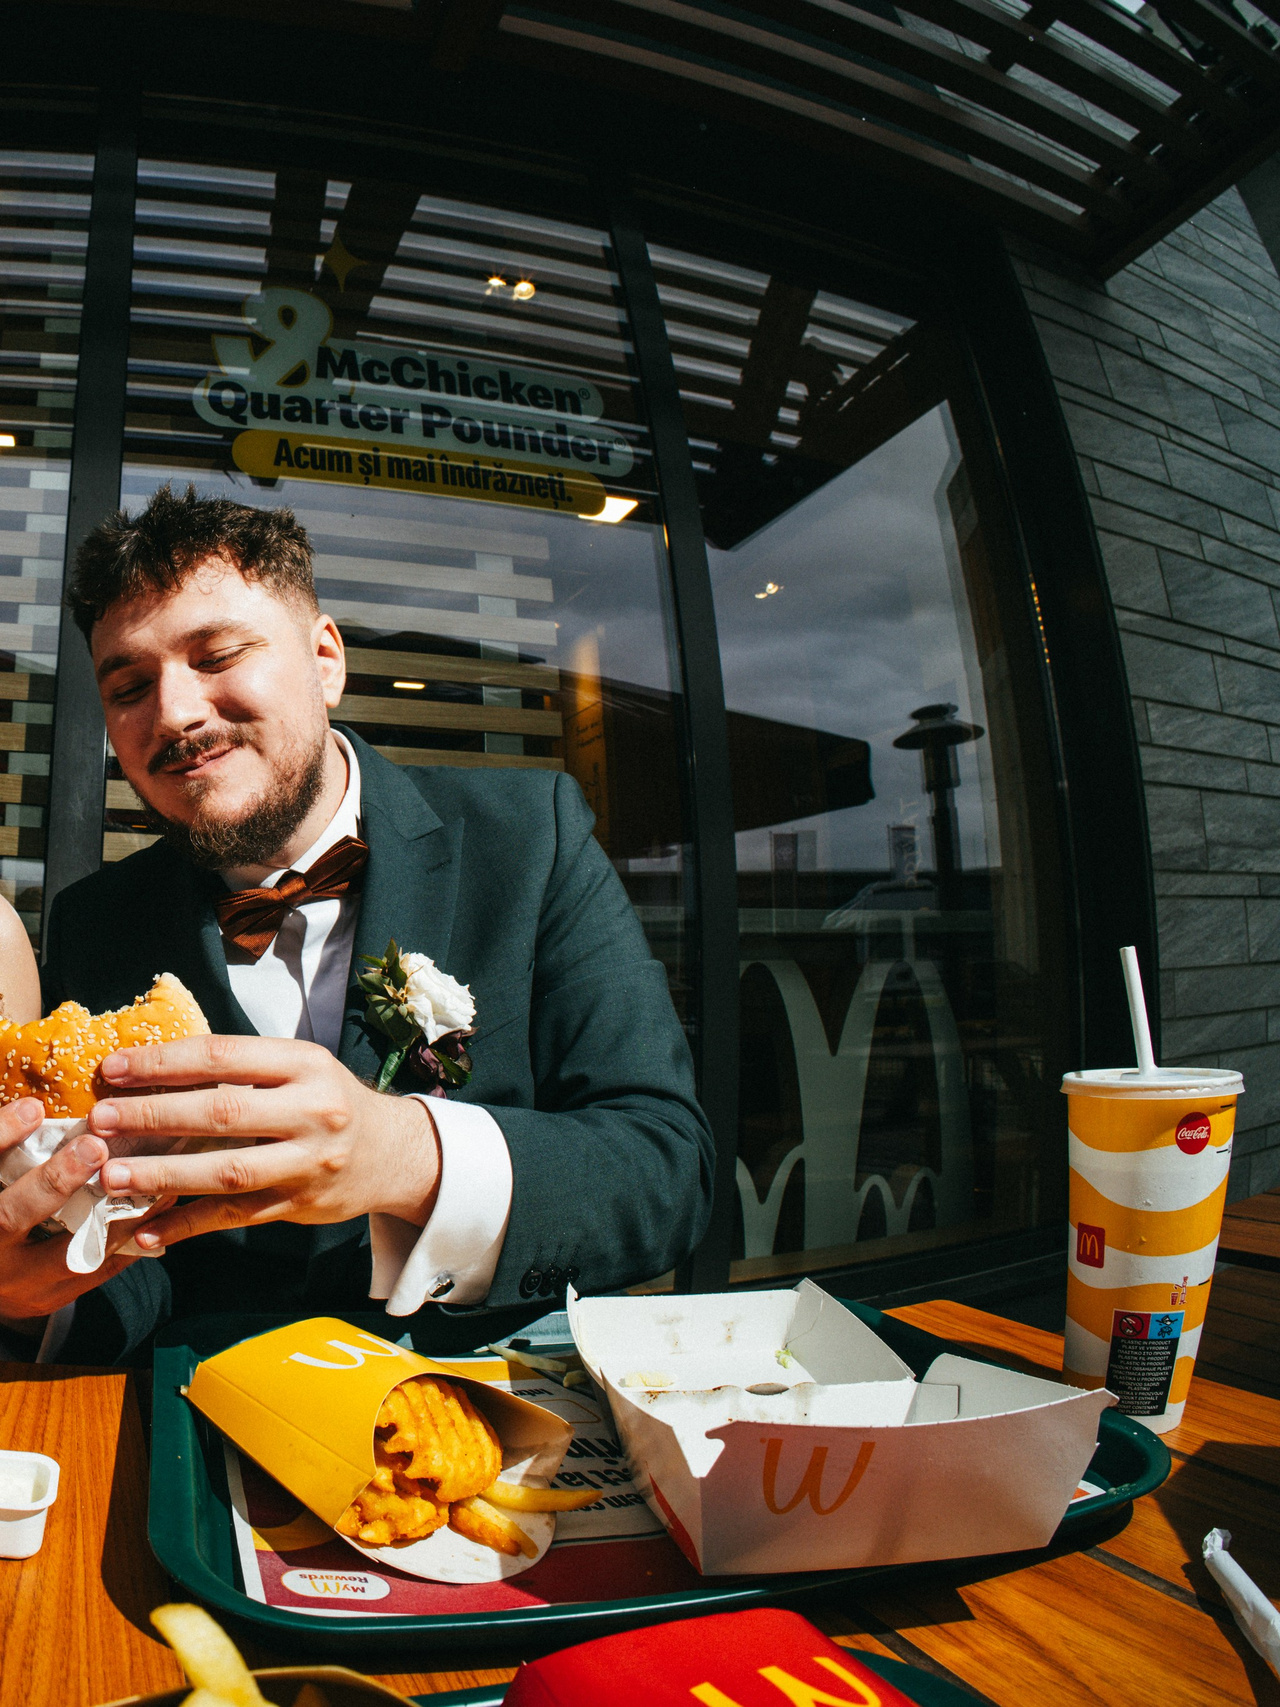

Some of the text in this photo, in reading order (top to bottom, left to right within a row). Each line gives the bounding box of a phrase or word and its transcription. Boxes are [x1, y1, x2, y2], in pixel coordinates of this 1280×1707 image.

[208, 380, 410, 434] Quarter
[273, 438, 353, 474] Acum
[387, 453, 436, 483] mai
[1177, 1126, 1210, 1140] Coca-Cola
[298, 1573, 369, 1583] Rewards
[342, 1583, 366, 1594] My
